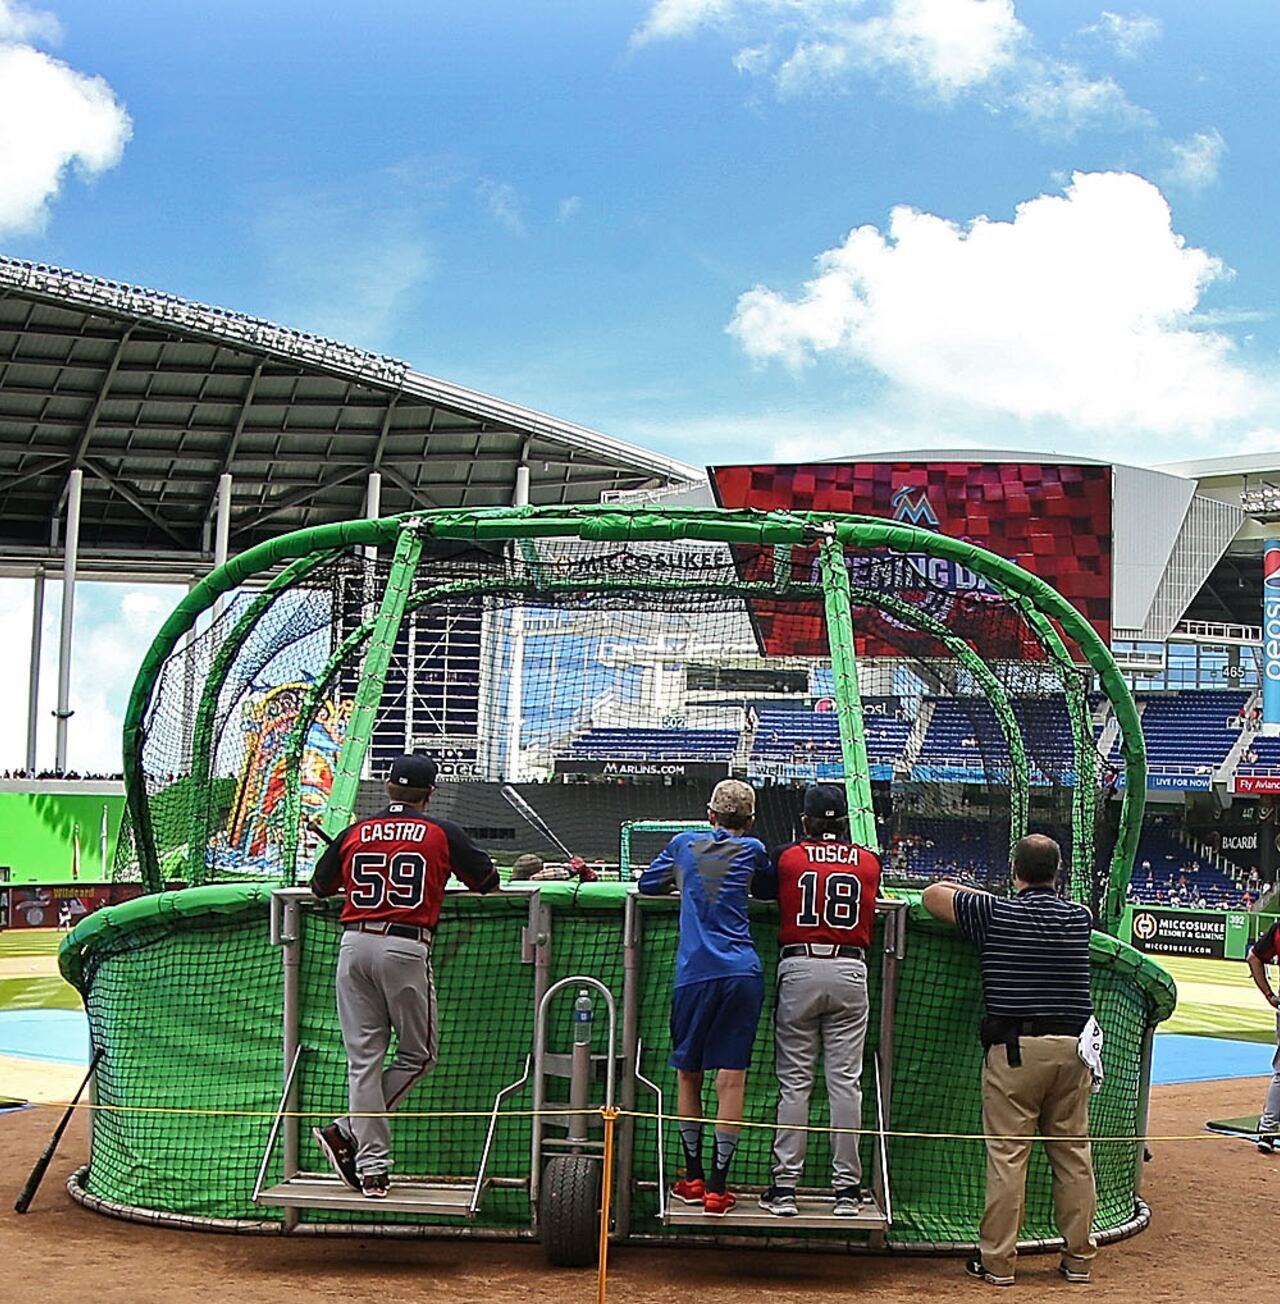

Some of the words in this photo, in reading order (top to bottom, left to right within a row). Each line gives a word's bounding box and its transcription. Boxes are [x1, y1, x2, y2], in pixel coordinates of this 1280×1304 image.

[578, 553, 727, 572] MICCOSUKEE
[1223, 667, 1245, 678] 465
[663, 717, 684, 728] 502
[1172, 779, 1188, 787] FOR
[1240, 780, 1252, 791] Fly
[361, 823, 426, 843] CASTRO
[1222, 832, 1258, 850] BACARDÍ
[804, 845, 859, 866] TOSCA
[351, 852, 427, 910] 59
[796, 871, 862, 930] 18
[1159, 918, 1225, 933] MICCOSUKEE
[1159, 928, 1187, 939] RESORT
[1194, 931, 1224, 941] GAMING
